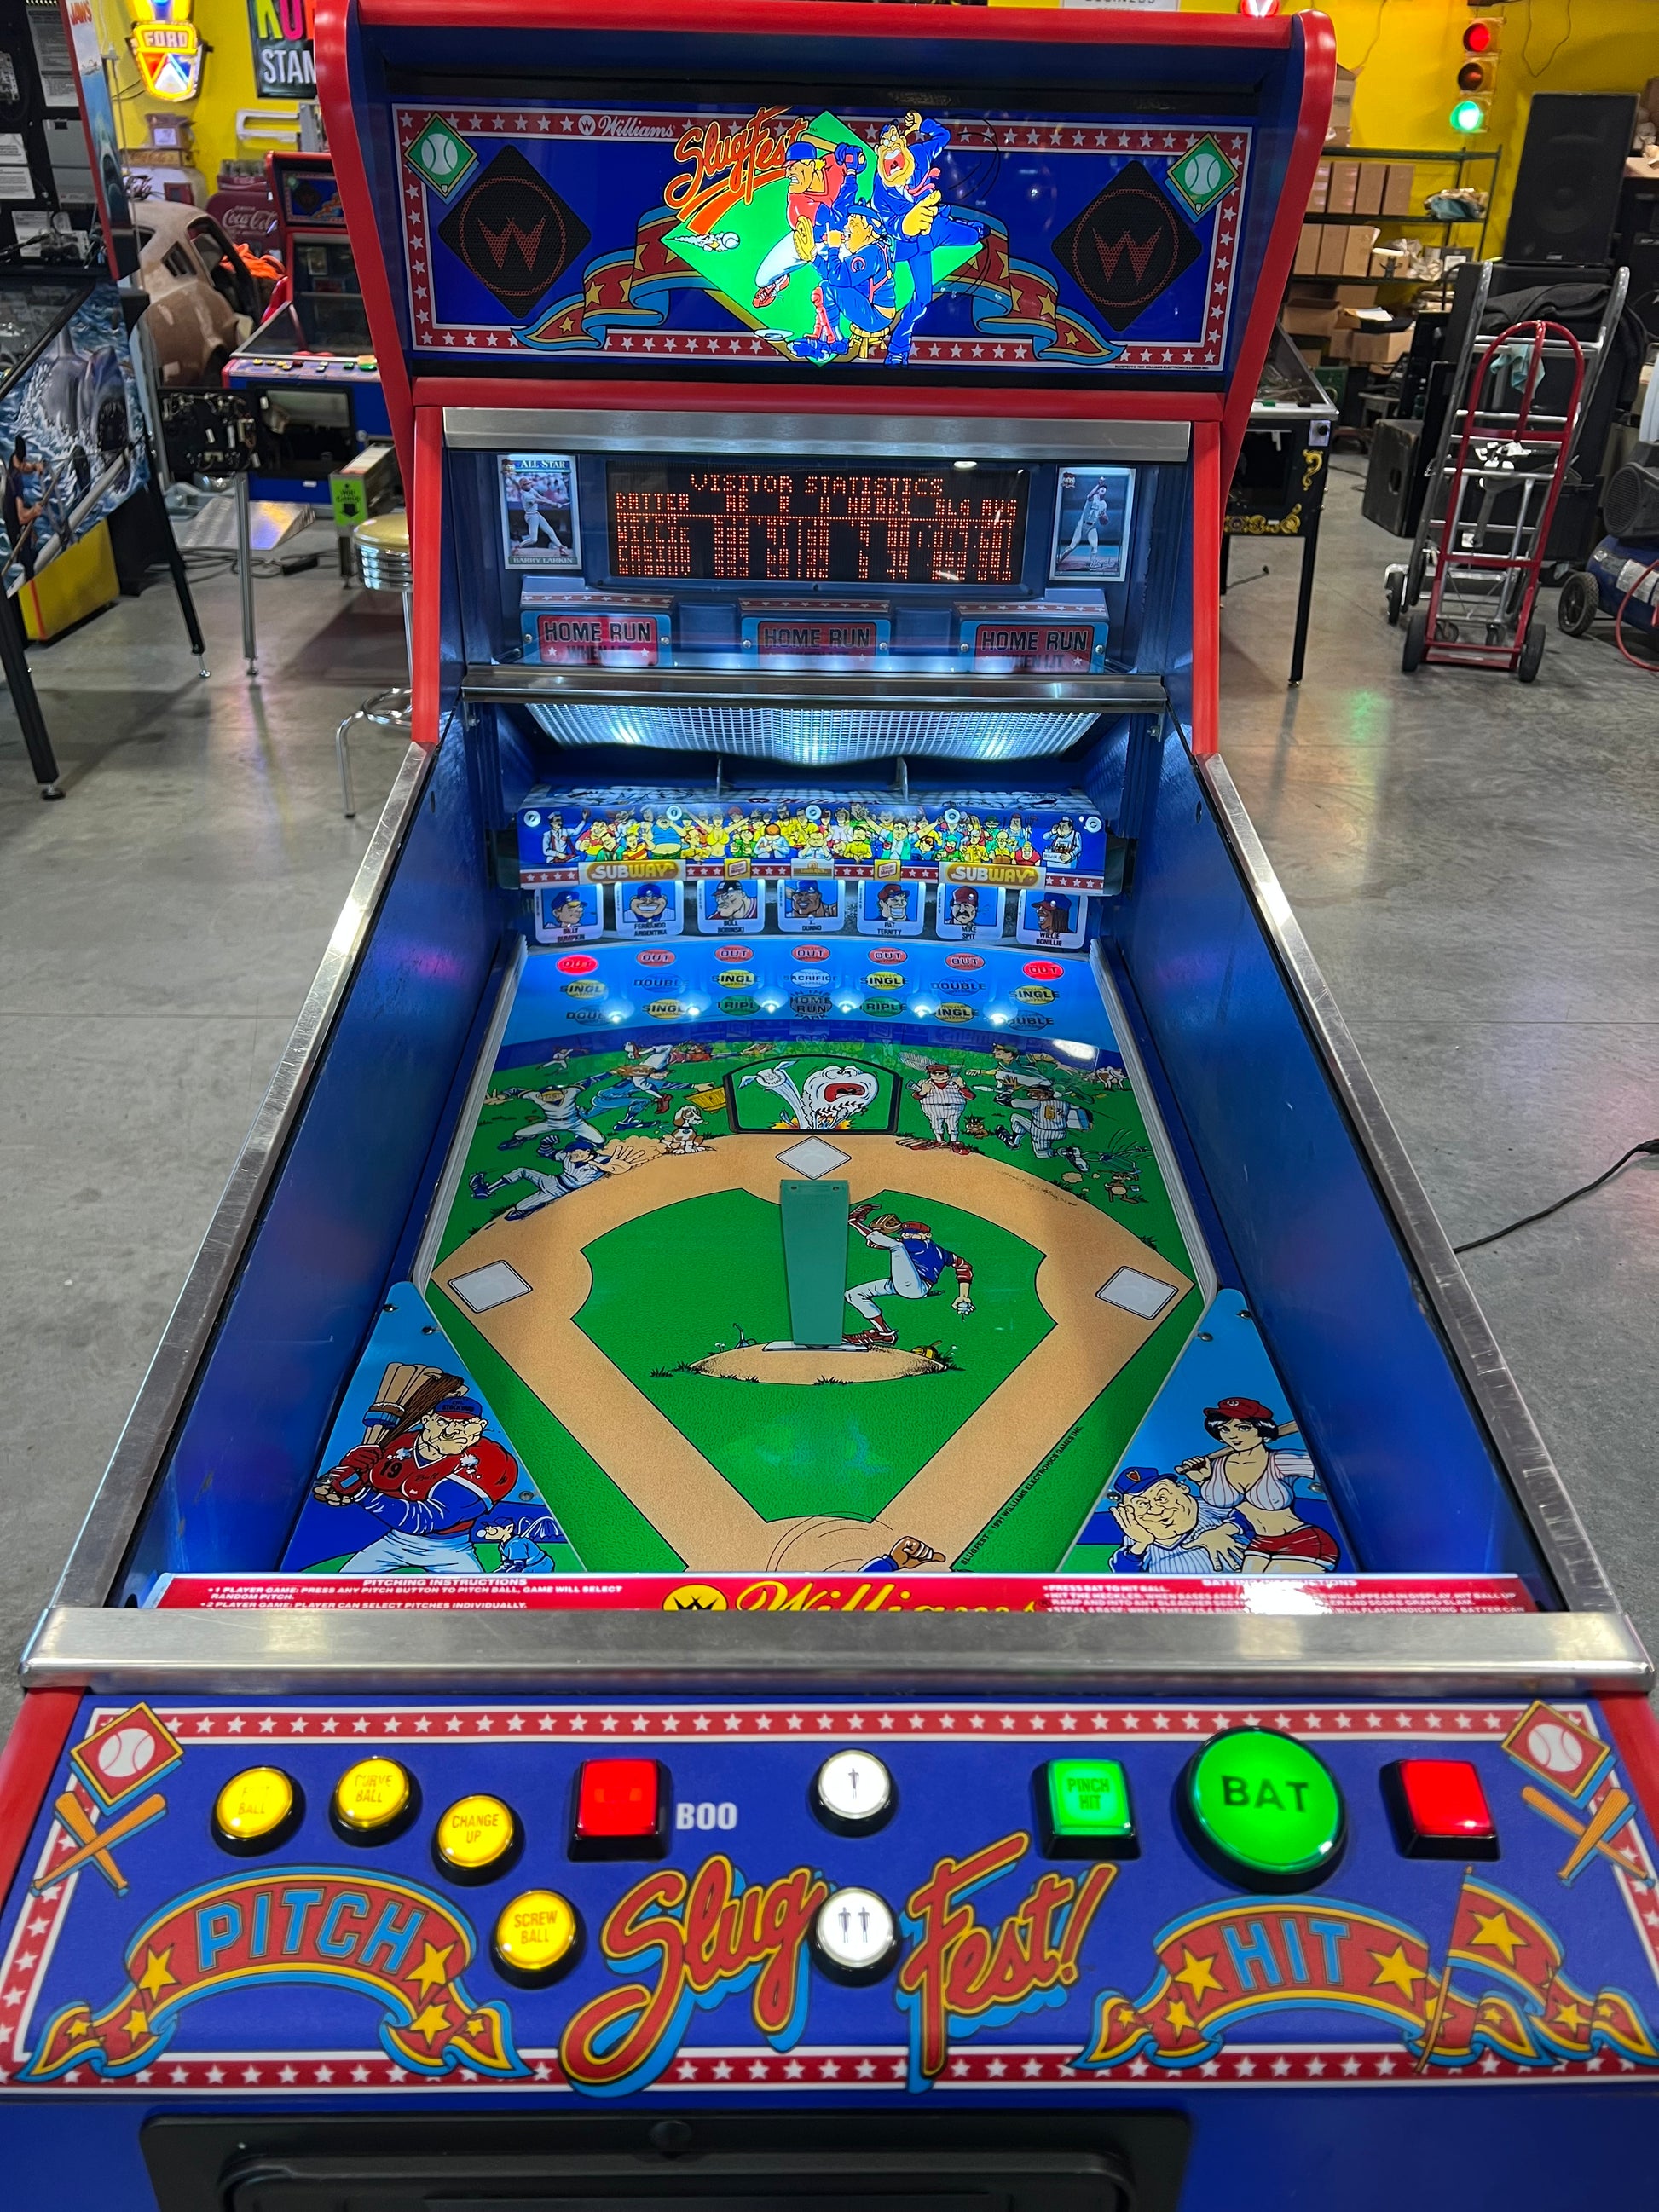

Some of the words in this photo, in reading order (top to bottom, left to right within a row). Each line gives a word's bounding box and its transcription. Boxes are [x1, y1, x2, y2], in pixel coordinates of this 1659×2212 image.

[146, 31, 188, 48] FORD
[598, 115, 674, 138] Williams
[542, 460, 565, 469] STAR
[691, 473, 793, 494] VISITOR
[805, 476, 944, 495] STATISTICS
[616, 492, 690, 511] BATTER
[725, 494, 749, 511] AB
[779, 495, 789, 512] R
[819, 496, 830, 513] H
[935, 499, 970, 516] SLG
[617, 525, 690, 543] WILLIE
[618, 545, 691, 563] CASINO
[543, 621, 602, 643] HOME
[609, 621, 652, 644] RUN
[764, 627, 822, 649] HOME
[828, 627, 871, 649] RUN
[980, 630, 1039, 651] HOME
[1046, 630, 1089, 651] RUN
[591, 863, 675, 880] SUBWAY
[951, 866, 1035, 883] SUBWAY
[641, 953, 670, 962] OUT
[720, 949, 749, 958] OUT
[796, 949, 824, 958] OUT
[874, 950, 904, 960] OUT
[950, 956, 980, 965] OUT
[564, 959, 592, 968] OUT
[1029, 965, 1058, 974] OUT
[860, 976, 910, 985] SINGLE
[930, 981, 987, 990] DOUBLE
[790, 996, 832, 1005] HOME
[1009, 990, 1061, 1000] SINGLE
[797, 1004, 827, 1014] RUN
[379, 1459, 402, 1479] 19
[991, 1516, 1005, 1530] 1991
[1002, 1488, 1029, 1517] WILLIAMS
[1025, 1453, 1060, 1491] ELECTRONICS
[1056, 1435, 1075, 1455] GAMES
[429, 1578, 528, 1586] INSTRUCTIONS
[354, 1774, 394, 1788] CURVE
[1067, 1776, 1111, 1793] PINCH
[356, 1789, 383, 1804] BALL
[1078, 1793, 1101, 1811] HIT
[1221, 1775, 1309, 1813] BAT
[237, 1802, 267, 1816] BALL
[675, 1802, 737, 1831] BOO
[451, 1814, 500, 1829] CHANGE
[465, 1829, 484, 1844] UP
[513, 1909, 558, 1930] SCREW
[194, 1886, 429, 1974] PITCH
[520, 1928, 551, 1944] BALL
[558, 1854, 830, 2085] Slug
[900, 1830, 1118, 2076] Fest!
[1219, 1915, 1350, 1992] HIT
